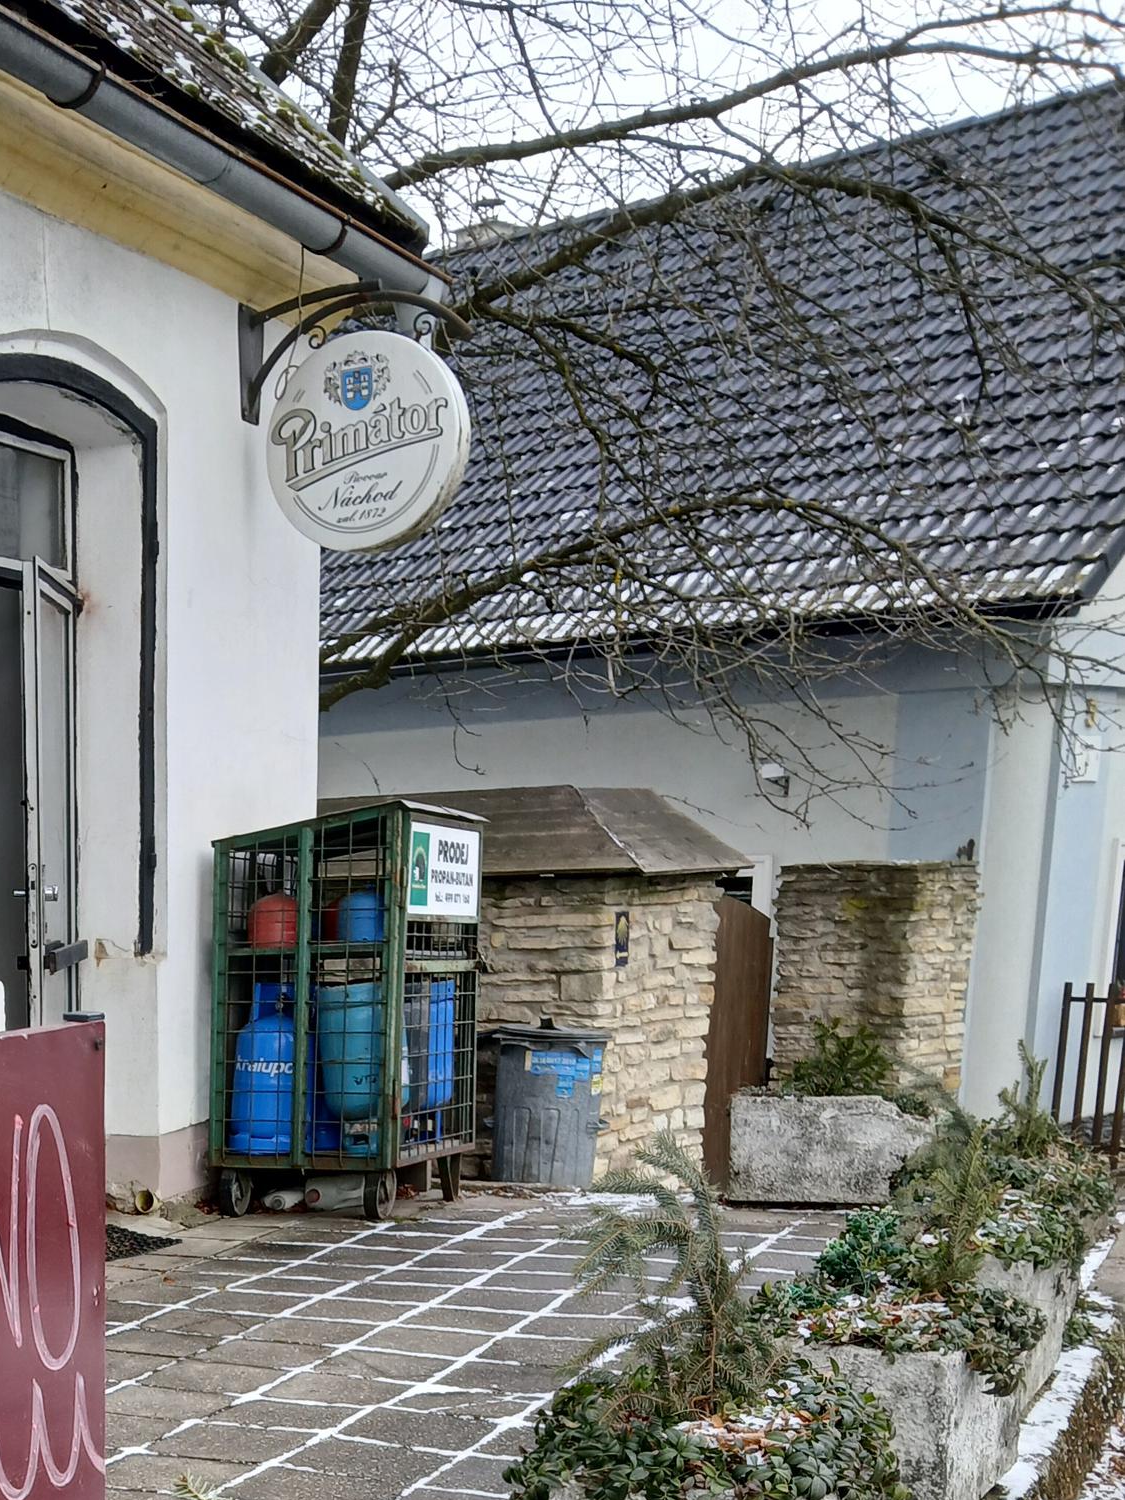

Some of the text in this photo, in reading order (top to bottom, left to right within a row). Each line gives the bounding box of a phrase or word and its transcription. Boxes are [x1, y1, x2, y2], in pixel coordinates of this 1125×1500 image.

[271, 397, 449, 484] Primátor
[318, 480, 403, 511] Náchod
[358, 507, 387, 521] 1872
[437, 839, 470, 866] PRODEJ
